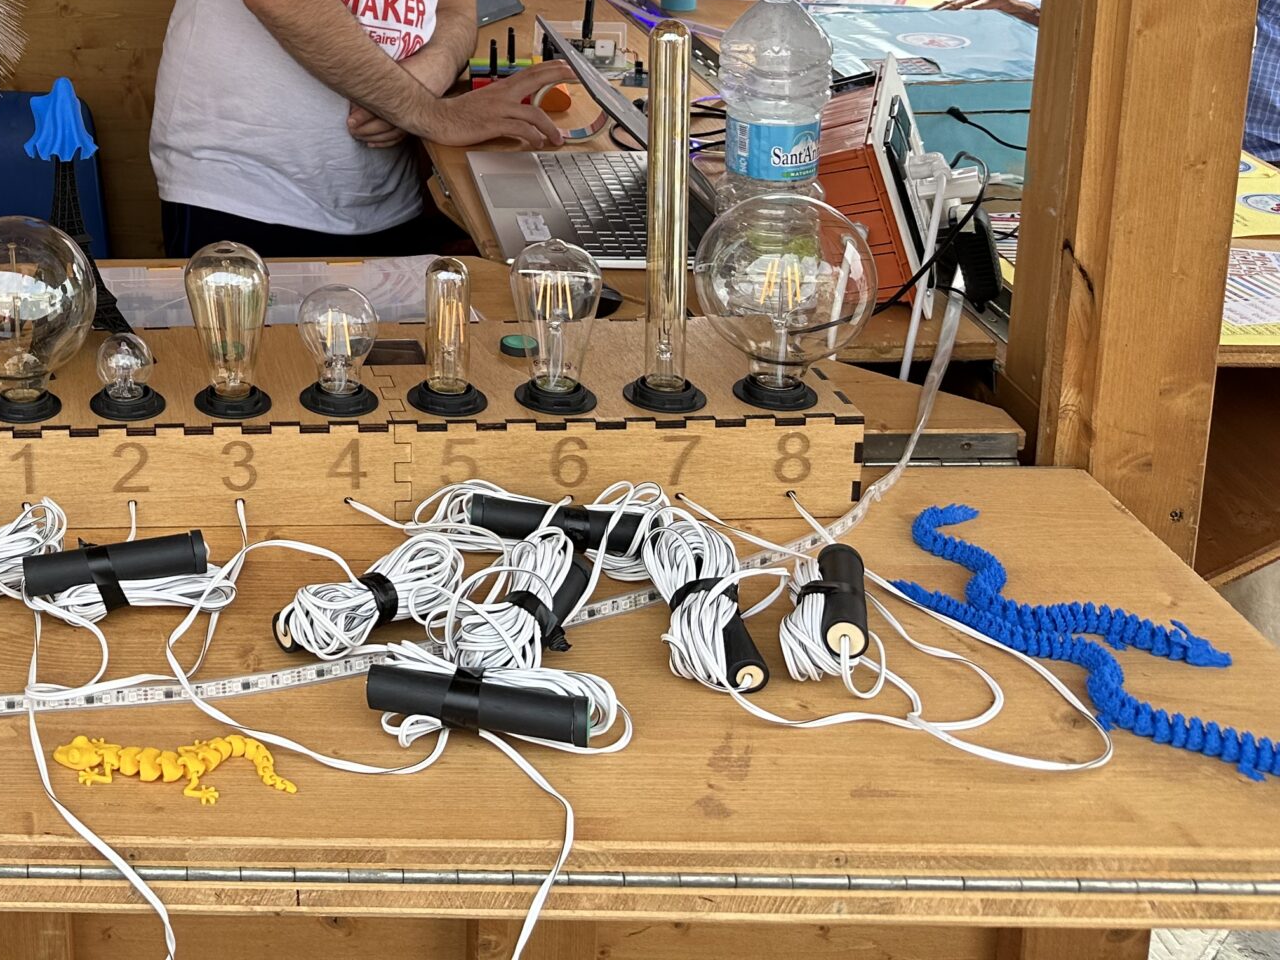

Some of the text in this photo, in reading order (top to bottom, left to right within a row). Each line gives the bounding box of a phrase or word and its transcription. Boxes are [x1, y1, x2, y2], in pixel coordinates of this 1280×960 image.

[772, 145, 819, 166] Sant'An
[9, 431, 812, 495] 1 2 3 4 5 6 7 8
